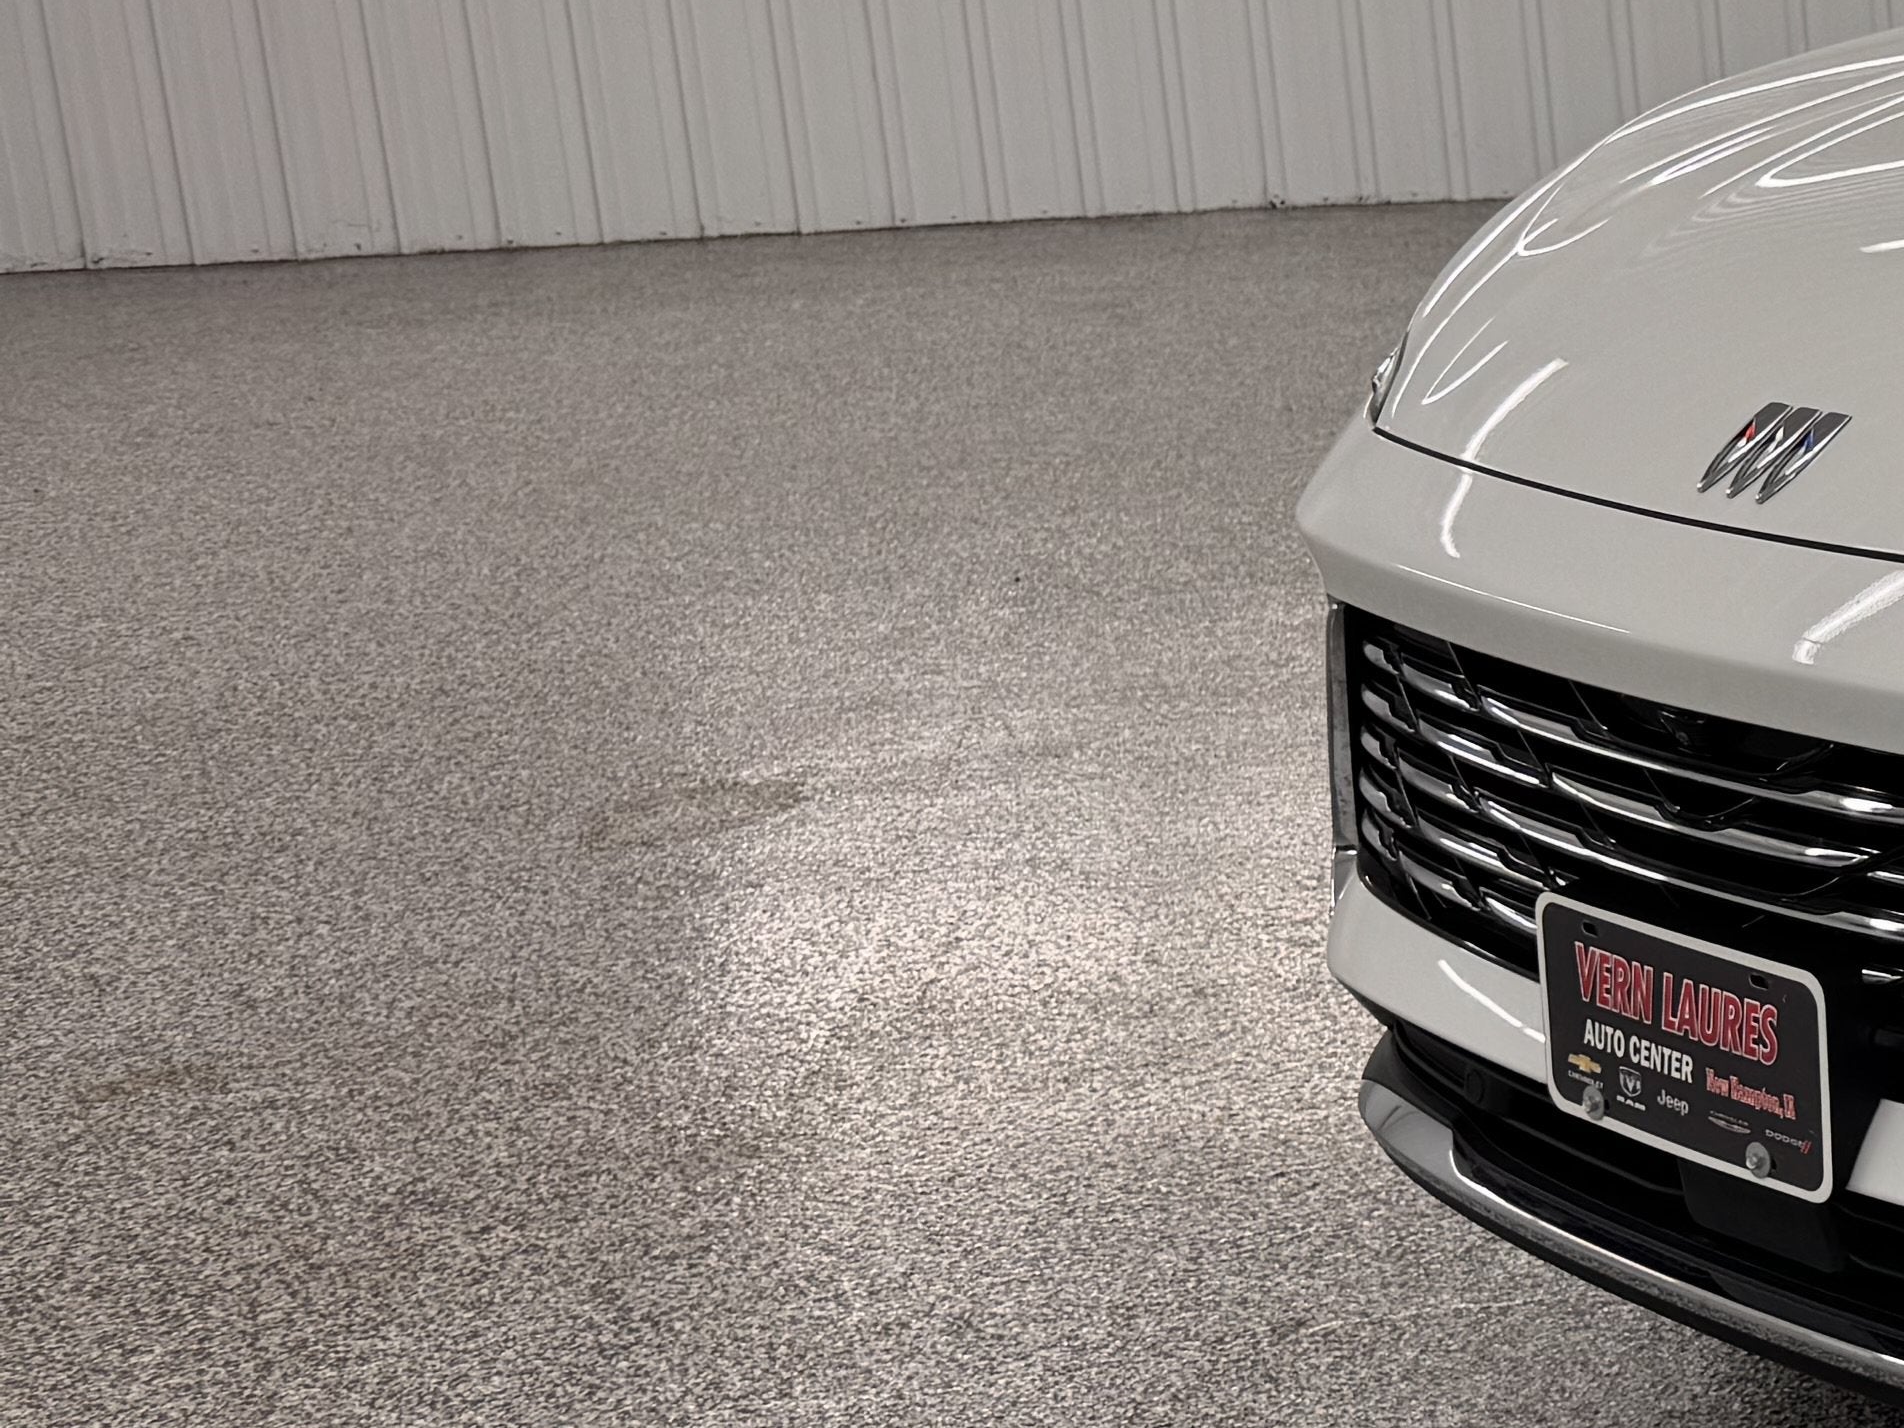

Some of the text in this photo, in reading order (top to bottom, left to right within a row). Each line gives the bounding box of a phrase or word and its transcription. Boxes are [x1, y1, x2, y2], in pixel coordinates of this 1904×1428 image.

[1573, 941, 1778, 1066] VERN LAURES
[1584, 1018, 1693, 1083] AUTO CENTER
[1656, 1088, 1690, 1116] Jeep
[1765, 1128, 1805, 1149] DODGE
